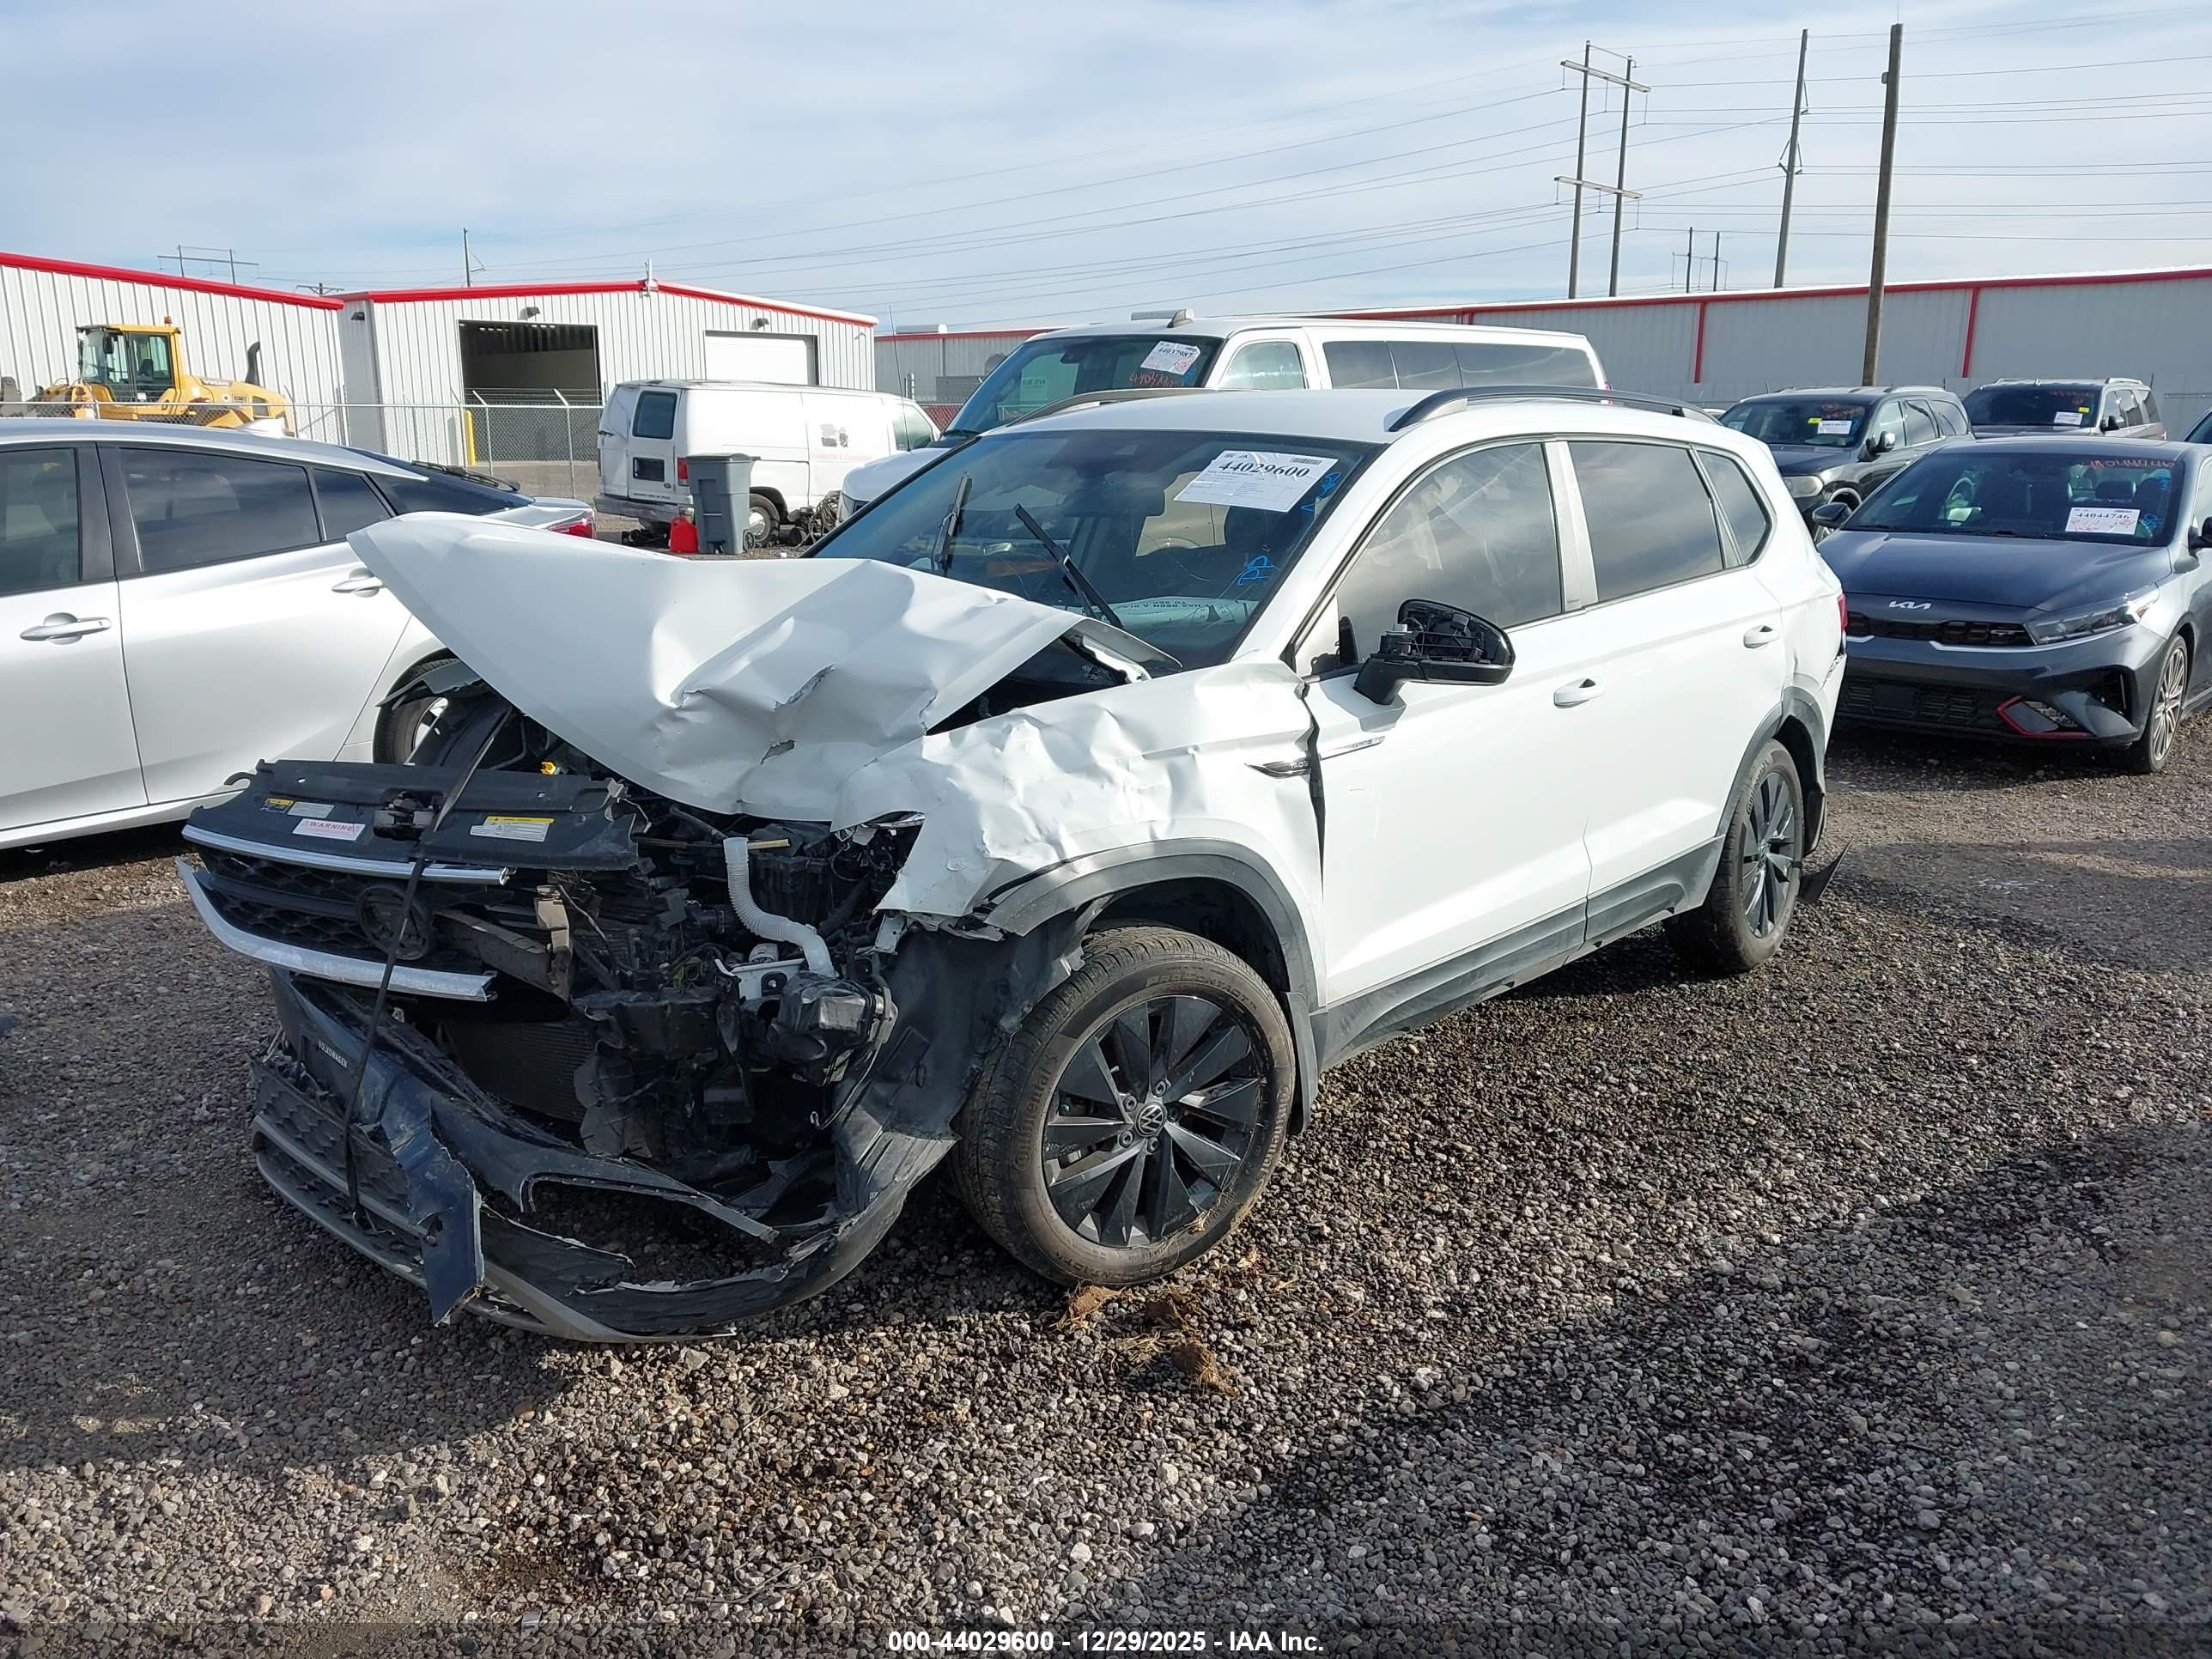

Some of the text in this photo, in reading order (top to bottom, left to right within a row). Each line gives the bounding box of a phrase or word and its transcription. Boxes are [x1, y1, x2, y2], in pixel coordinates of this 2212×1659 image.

[1218, 460, 1310, 478] 44029600
[2076, 512, 2130, 520] 44044746
[1889, 600, 1932, 610] KIA
[1291, 760, 1310, 769] TAOS
[309, 821, 353, 831] WARNING
[318, 1038, 348, 1069] VOLKSWAGEN
